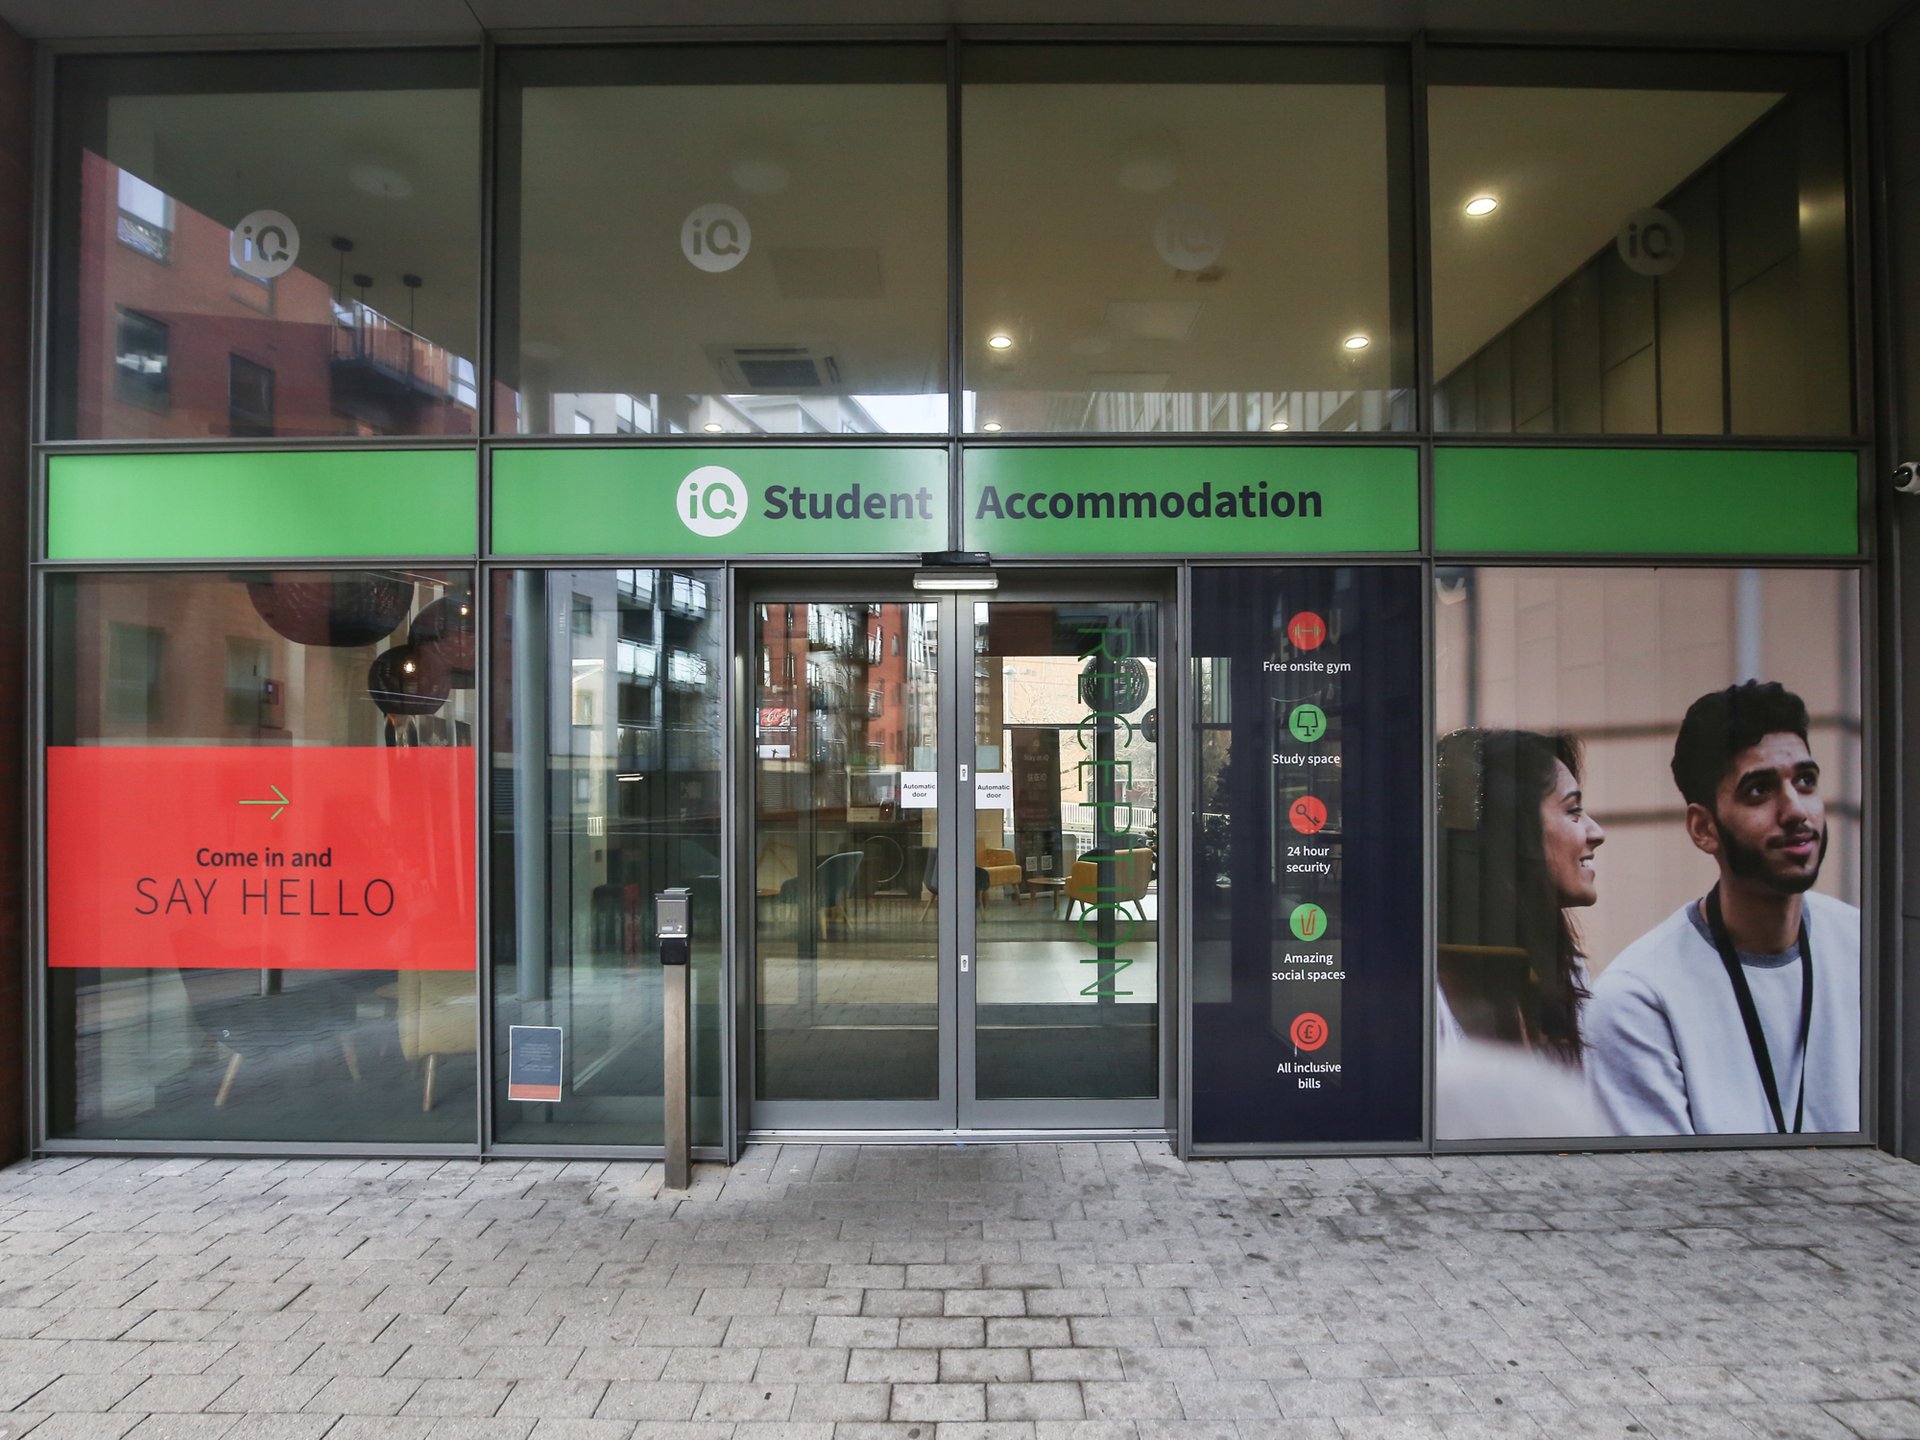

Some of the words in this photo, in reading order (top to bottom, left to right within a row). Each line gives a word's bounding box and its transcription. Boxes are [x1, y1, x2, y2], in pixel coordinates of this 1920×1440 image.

[243, 225, 290, 262] iQ
[693, 218, 741, 256] iQ
[1629, 222, 1674, 260] iQ
[689, 482, 738, 520] iQ
[764, 485, 933, 519] Student
[977, 480, 1323, 519] Accommodation
[1263, 661, 1287, 672] Free
[1290, 660, 1324, 672] onsite
[1326, 662, 1351, 675] gym
[1271, 753, 1306, 767] Study
[1307, 755, 1341, 767] space
[1077, 628, 1135, 997] RECEPTION
[196, 847, 258, 867] Come
[265, 847, 284, 867] in
[292, 846, 332, 868] and
[1287, 846, 1301, 857] 24
[1303, 845, 1330, 857] hour
[1286, 861, 1331, 875] security
[135, 878, 217, 915] SAY
[242, 878, 395, 917] HELLO
[1283, 951, 1334, 966] Amazing
[1271, 970, 1305, 981] social
[1307, 970, 1346, 983] spaces
[1276, 1062, 1292, 1073] All
[1293, 1061, 1342, 1073] inclusive
[1298, 1077, 1321, 1089] bills
